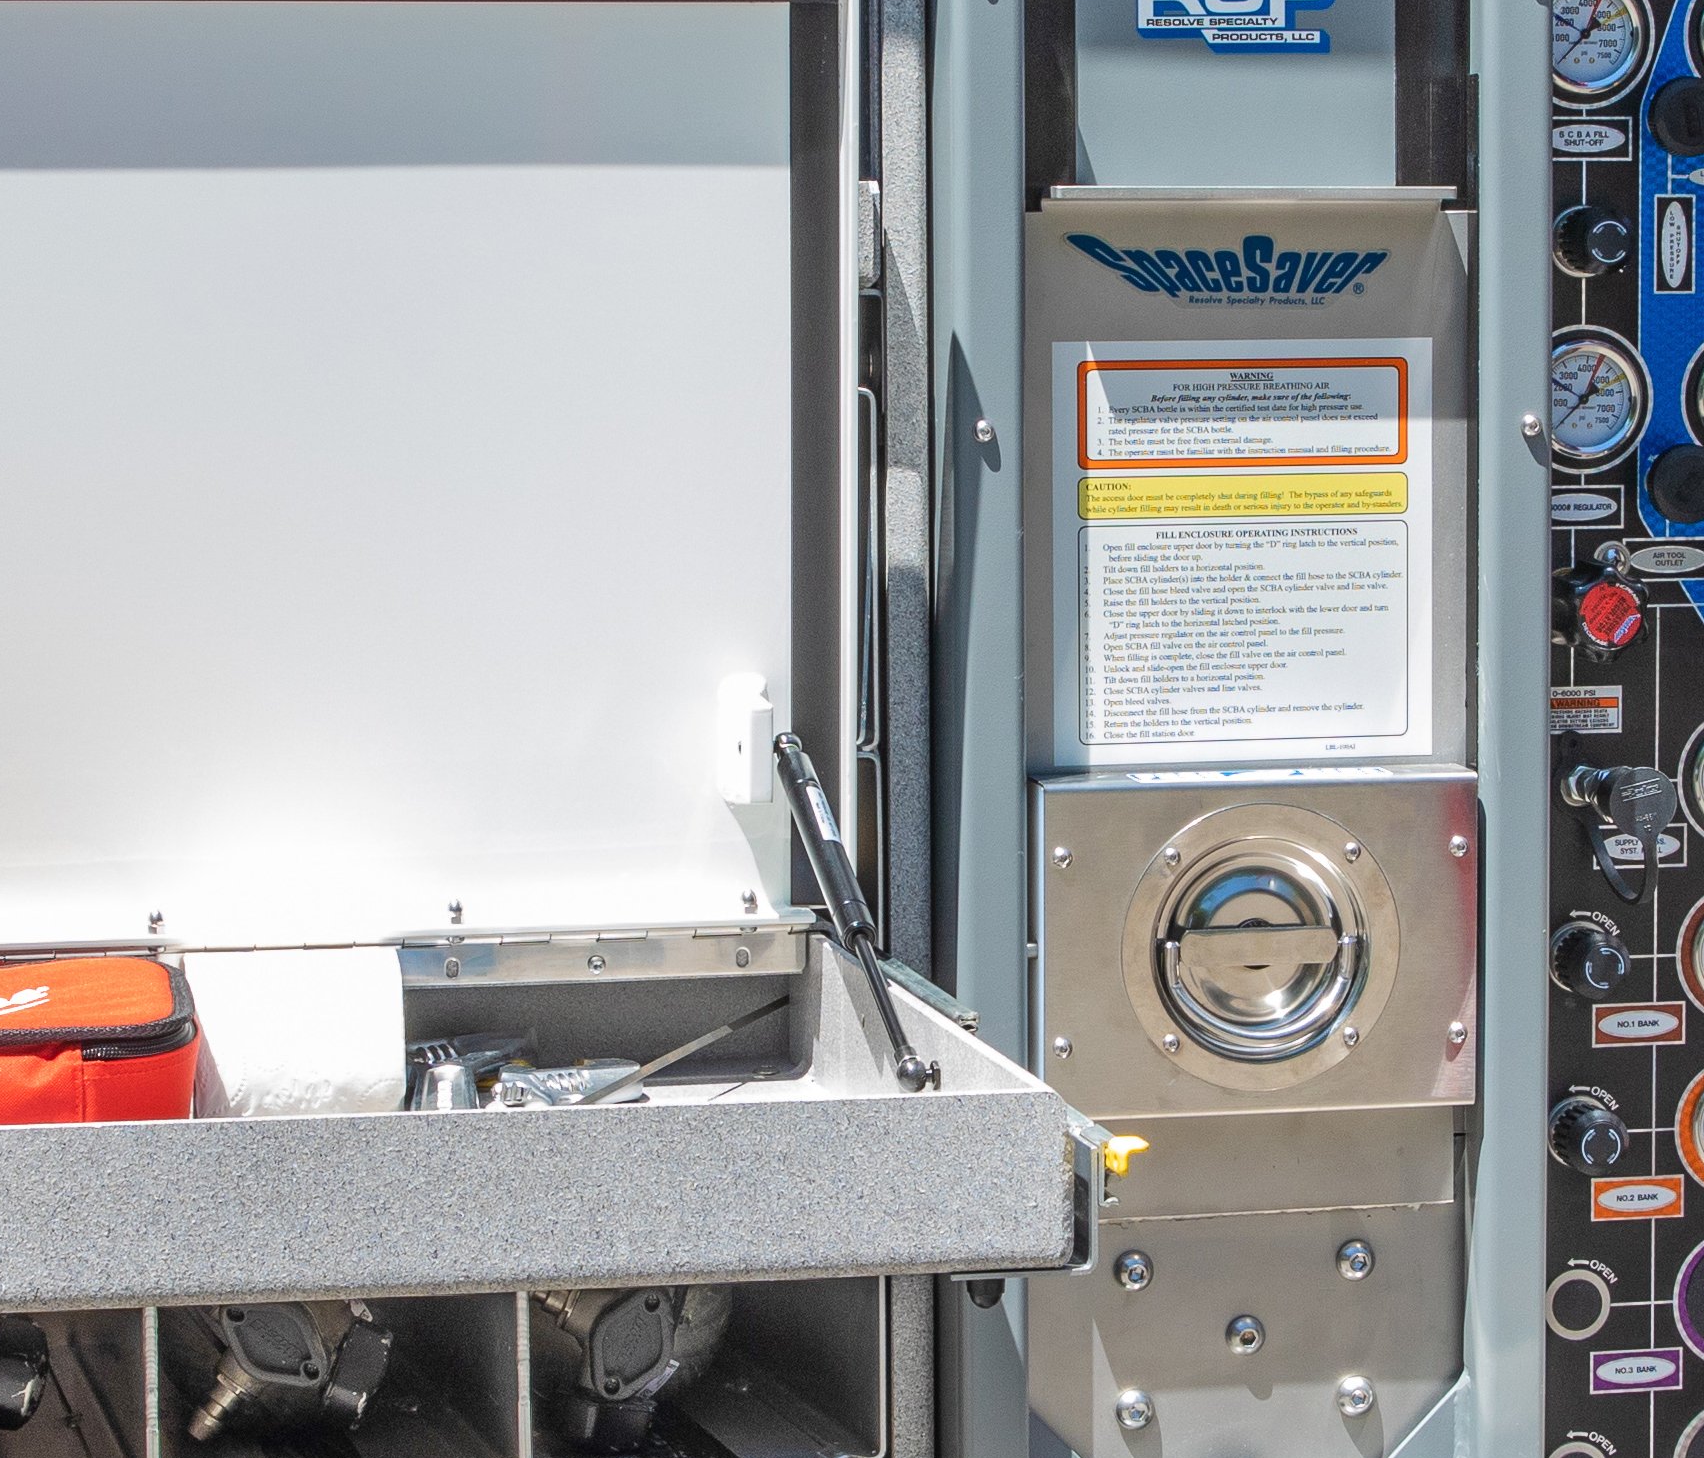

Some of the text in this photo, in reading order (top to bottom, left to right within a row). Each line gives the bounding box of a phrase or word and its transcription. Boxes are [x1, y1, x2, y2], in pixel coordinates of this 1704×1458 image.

[1146, 16, 1278, 27] RESOLVE SPECIALTY
[1212, 31, 1315, 43] PRODUCTS, LLC
[1564, 139, 1604, 147] SHUT-OFF
[1066, 233, 1389, 298] SpaceSaver
[1188, 295, 1223, 305] Resolve
[1225, 295, 1266, 307] Specialty
[1310, 295, 1326, 305] LLC
[1230, 371, 1274, 381] WARNING
[1173, 382, 1330, 392] FOR HIGH PRESSURE BREATHING AIR
[1151, 394, 1176, 403] Before
[1201, 396, 1216, 404] any
[1251, 394, 1271, 402] make
[1290, 393, 1300, 402] of
[1301, 393, 1312, 401] the
[1086, 482, 1132, 492] CAUTION:
[1574, 503, 1612, 511] REGULATOR
[1156, 528, 1358, 539] FILL ENCLOSURE OPERATING INSTRUCTIONS
[1655, 559, 1684, 567] OUTLET
[1591, 911, 1621, 937] OPEN
[1617, 1019, 1660, 1029] NO.1 BANK
[1590, 1086, 1620, 1111] OPEN
[1616, 1194, 1659, 1203] NO.2 BANK
[1589, 1259, 1618, 1285] OPEN
[1614, 1365, 1657, 1375] NO.3 BANK
[1588, 1431, 1617, 1456] OPEN
